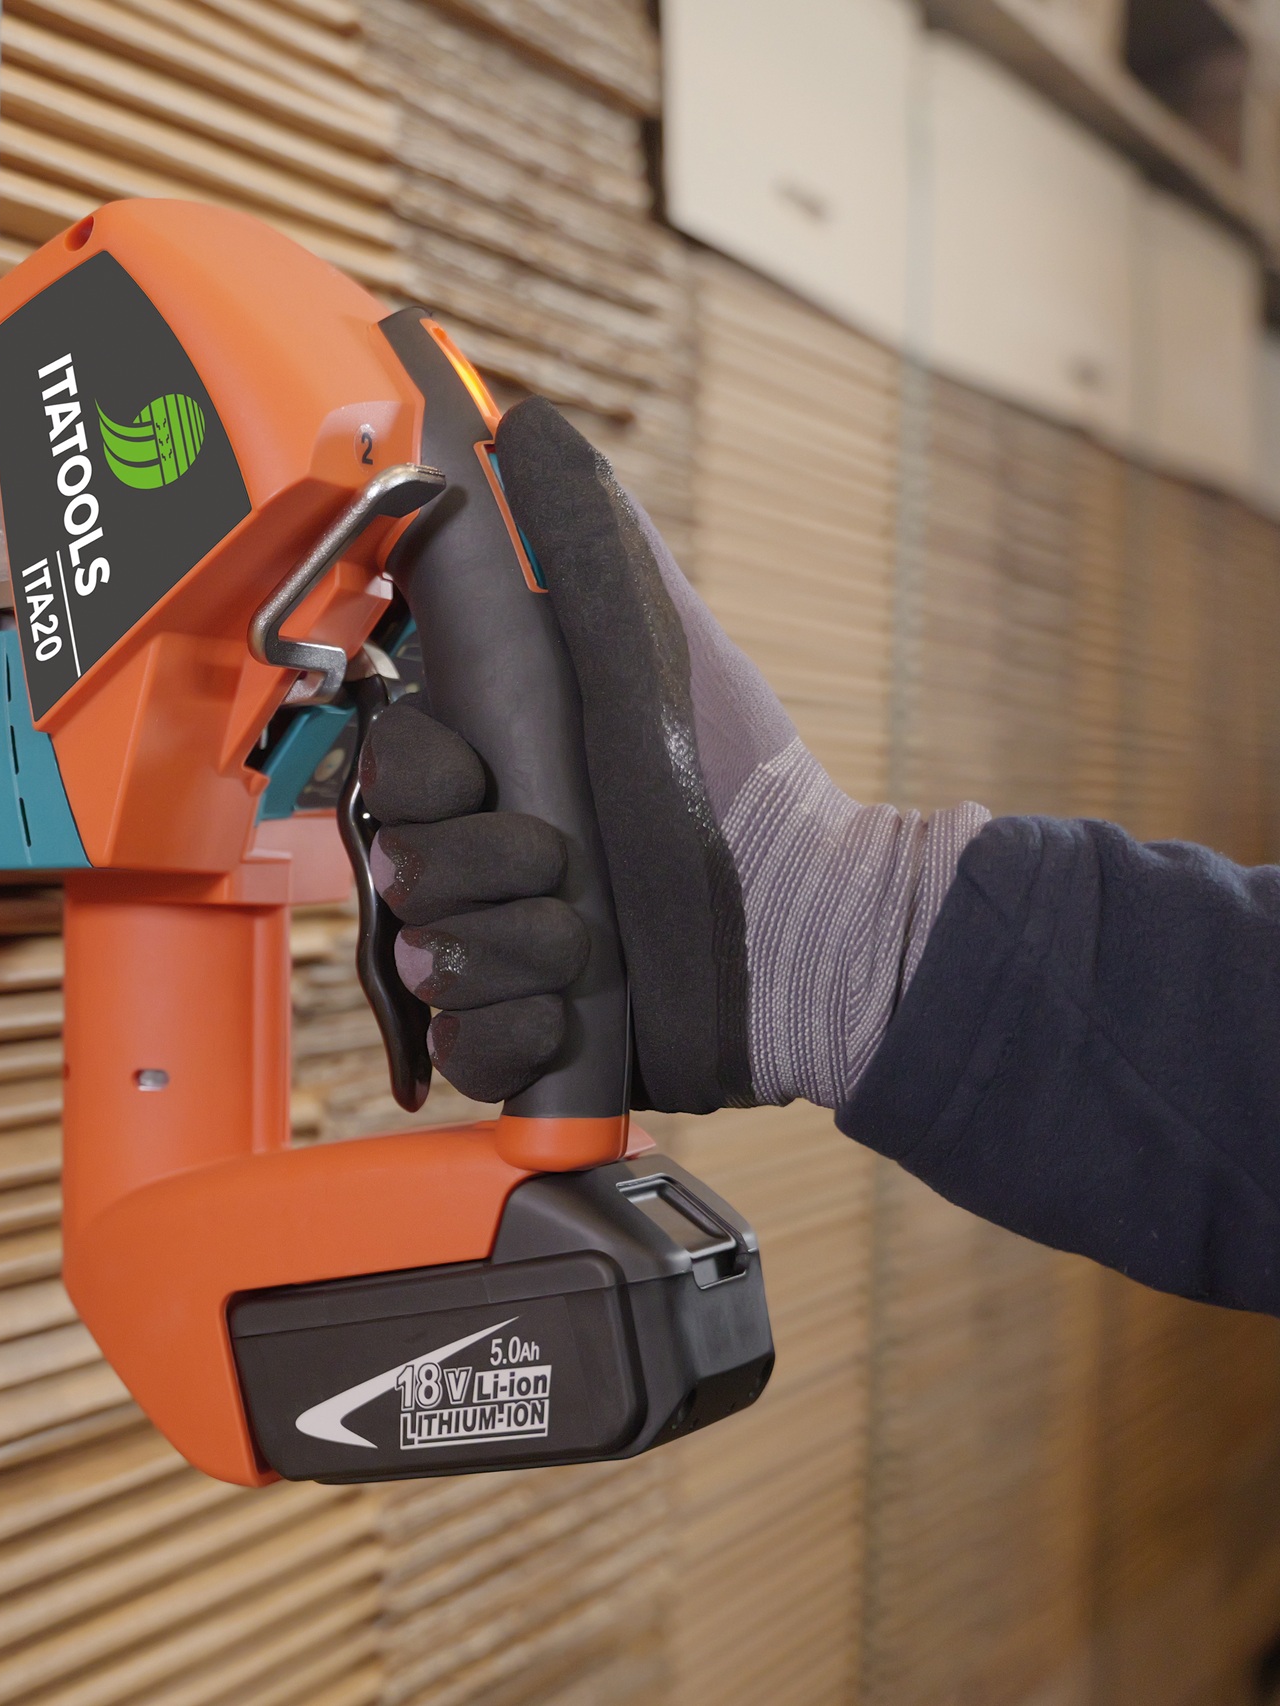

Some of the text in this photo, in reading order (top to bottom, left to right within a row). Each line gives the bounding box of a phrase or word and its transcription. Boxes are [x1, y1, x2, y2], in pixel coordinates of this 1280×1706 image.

[361, 432, 373, 465] 2
[38, 352, 111, 597] ITATOOLS
[22, 558, 63, 662] ITA20
[490, 1336, 540, 1366] 5.0Ah
[477, 1372, 548, 1400] Li-ion
[402, 1401, 545, 1445] LITHIUM-ION
